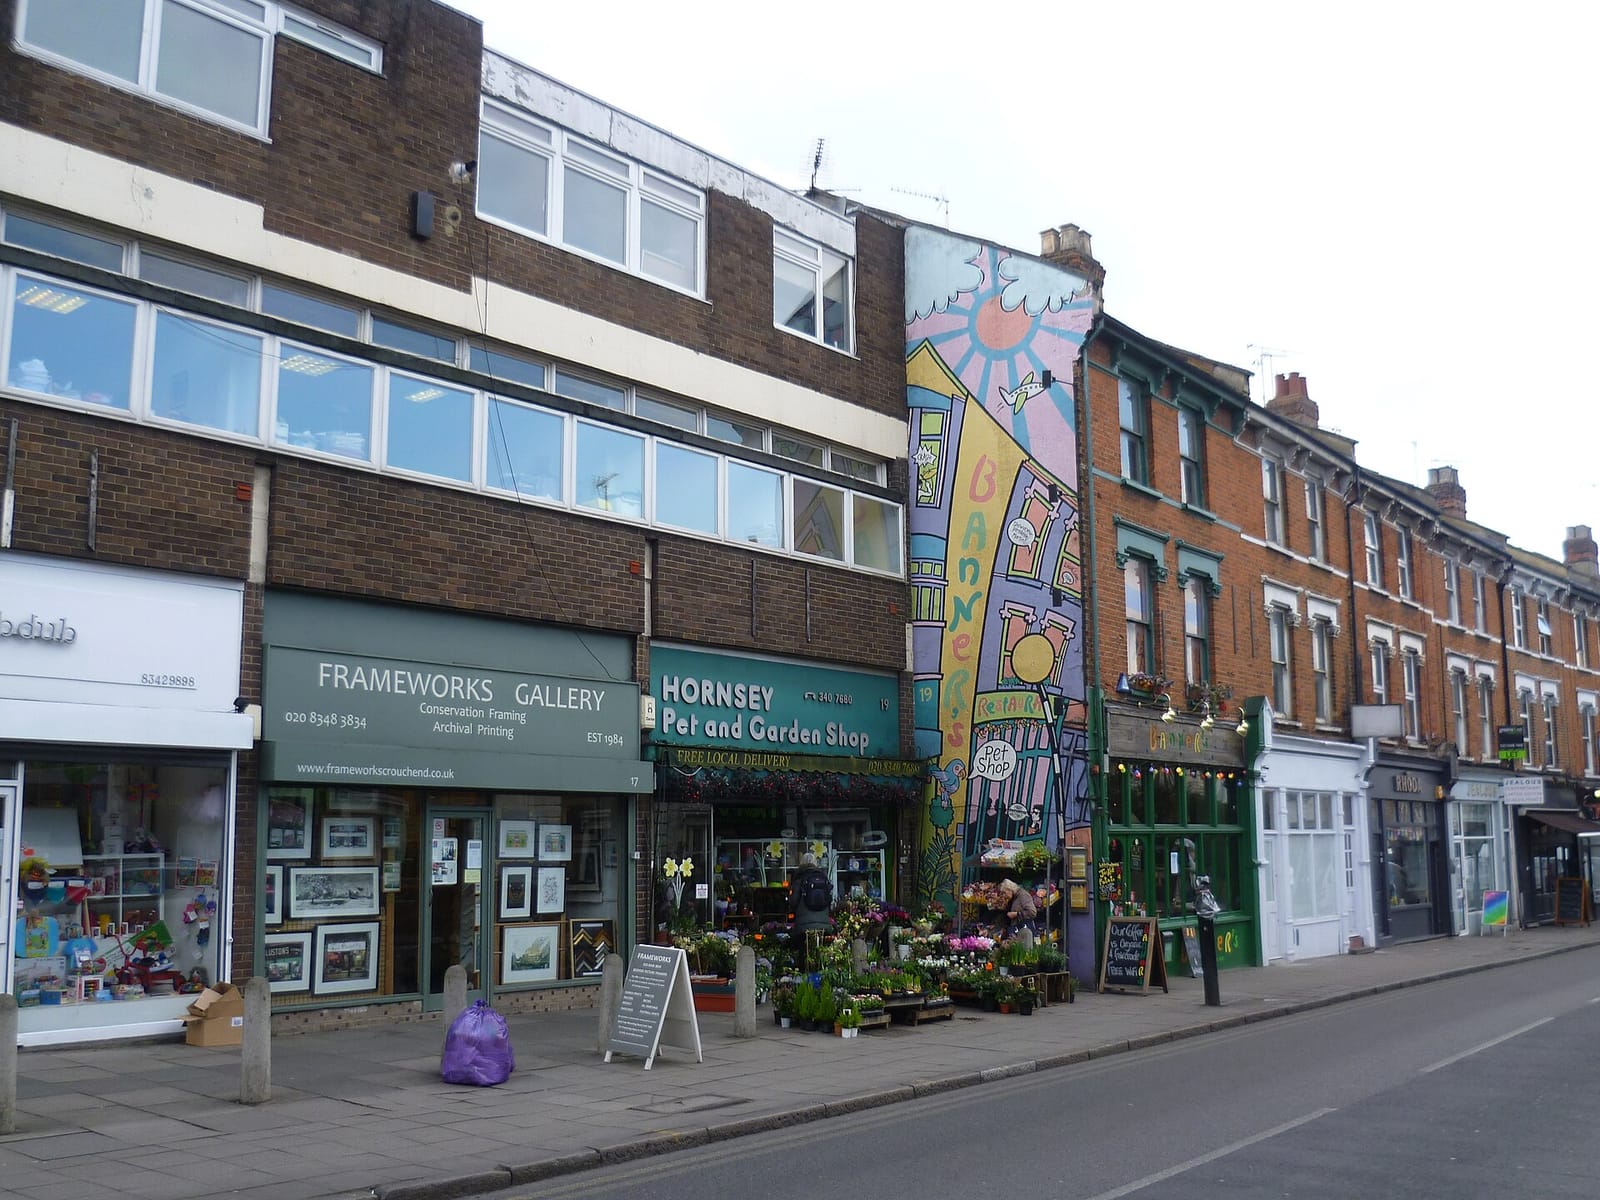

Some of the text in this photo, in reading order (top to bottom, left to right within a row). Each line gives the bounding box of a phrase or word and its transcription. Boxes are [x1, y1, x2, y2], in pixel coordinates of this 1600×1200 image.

[141, 673, 195, 687] 83429898
[319, 662, 605, 711] FRAMEWORKS GALLERY
[662, 674, 774, 712] HORNSEY
[818, 692, 833, 703] 340
[919, 687, 933, 702] 19
[880, 698, 889, 711] 19
[285, 711, 367, 729] 020 8348 3834
[420, 702, 527, 724] Conservation Framing
[433, 721, 514, 740] Archival Printing
[662, 707, 870, 756] Pet and Garden Shop
[587, 732, 623, 746] EST 1984
[677, 750, 791, 767] FREE LOCAL DELIVERY
[297, 763, 455, 779] www.frameworkscrouchend.co.uk
[977, 757, 1010, 777] Shop
[630, 776, 639, 787] 17
[637, 953, 671, 963] FRAMEWORKS
